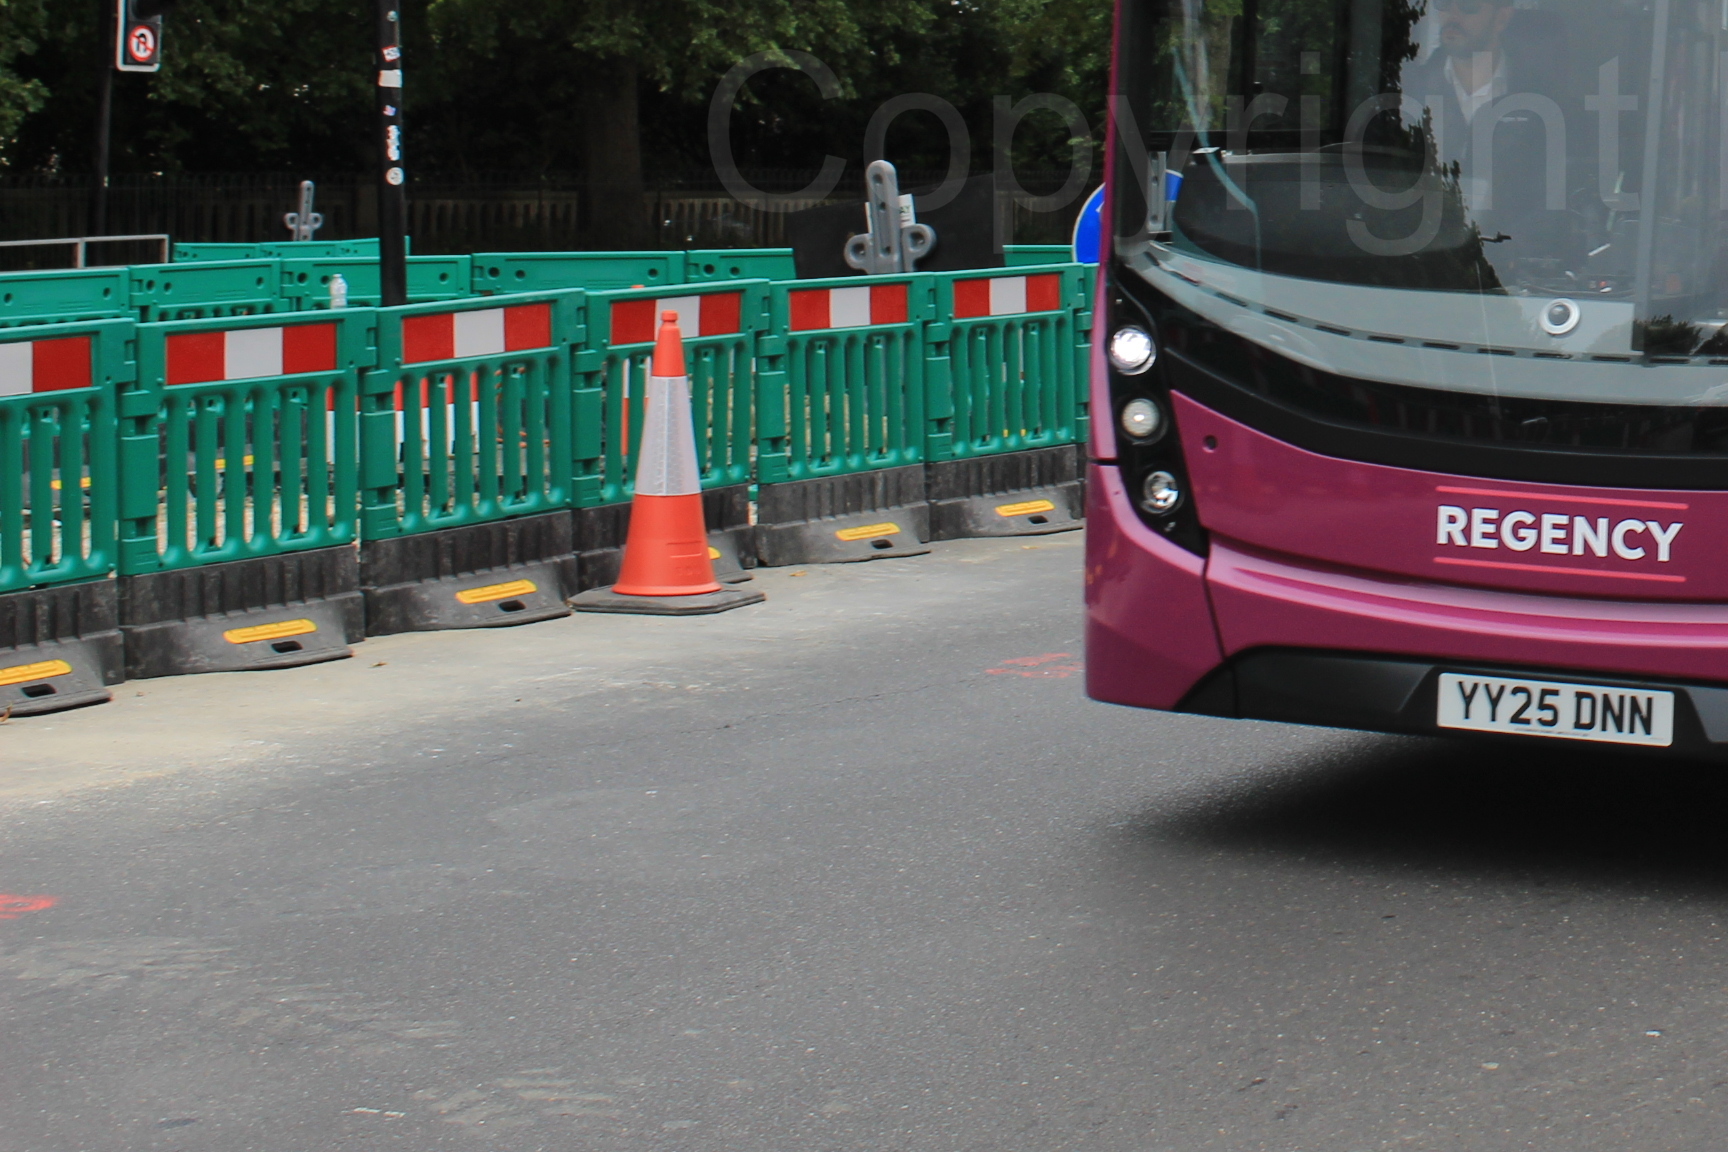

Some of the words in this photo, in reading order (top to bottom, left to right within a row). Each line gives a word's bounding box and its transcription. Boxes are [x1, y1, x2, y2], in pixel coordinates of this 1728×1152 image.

[1436, 504, 1684, 562] REGENCY
[1457, 680, 1560, 728] YY25
[1572, 690, 1653, 736] DNN
